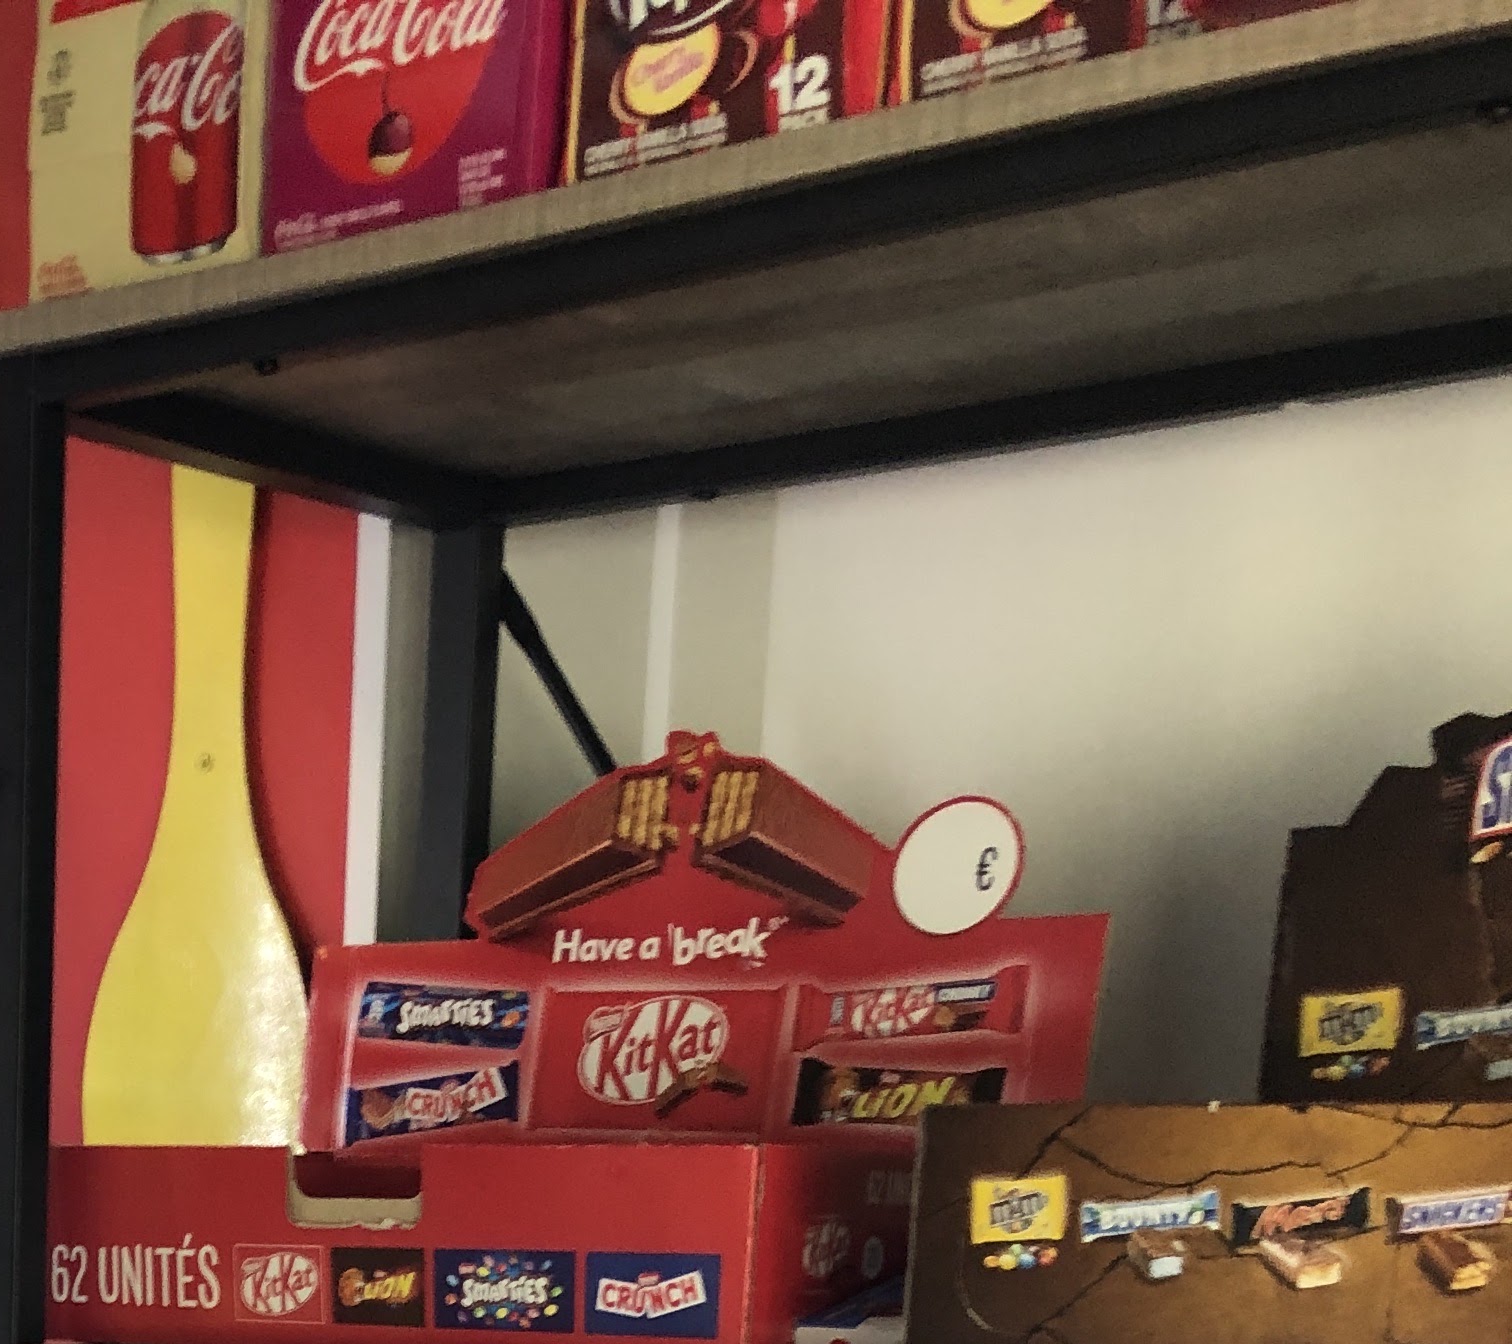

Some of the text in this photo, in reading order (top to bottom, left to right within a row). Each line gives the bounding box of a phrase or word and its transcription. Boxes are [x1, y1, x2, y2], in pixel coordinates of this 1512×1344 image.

[769, 53, 832, 114] 12
[551, 916, 770, 967] Have a break
[592, 999, 722, 1100] KitKat
[853, 1076, 956, 1119] LION
[51, 1231, 220, 1309] 62 UNITÉS
[601, 1275, 702, 1313] CRUNCH
